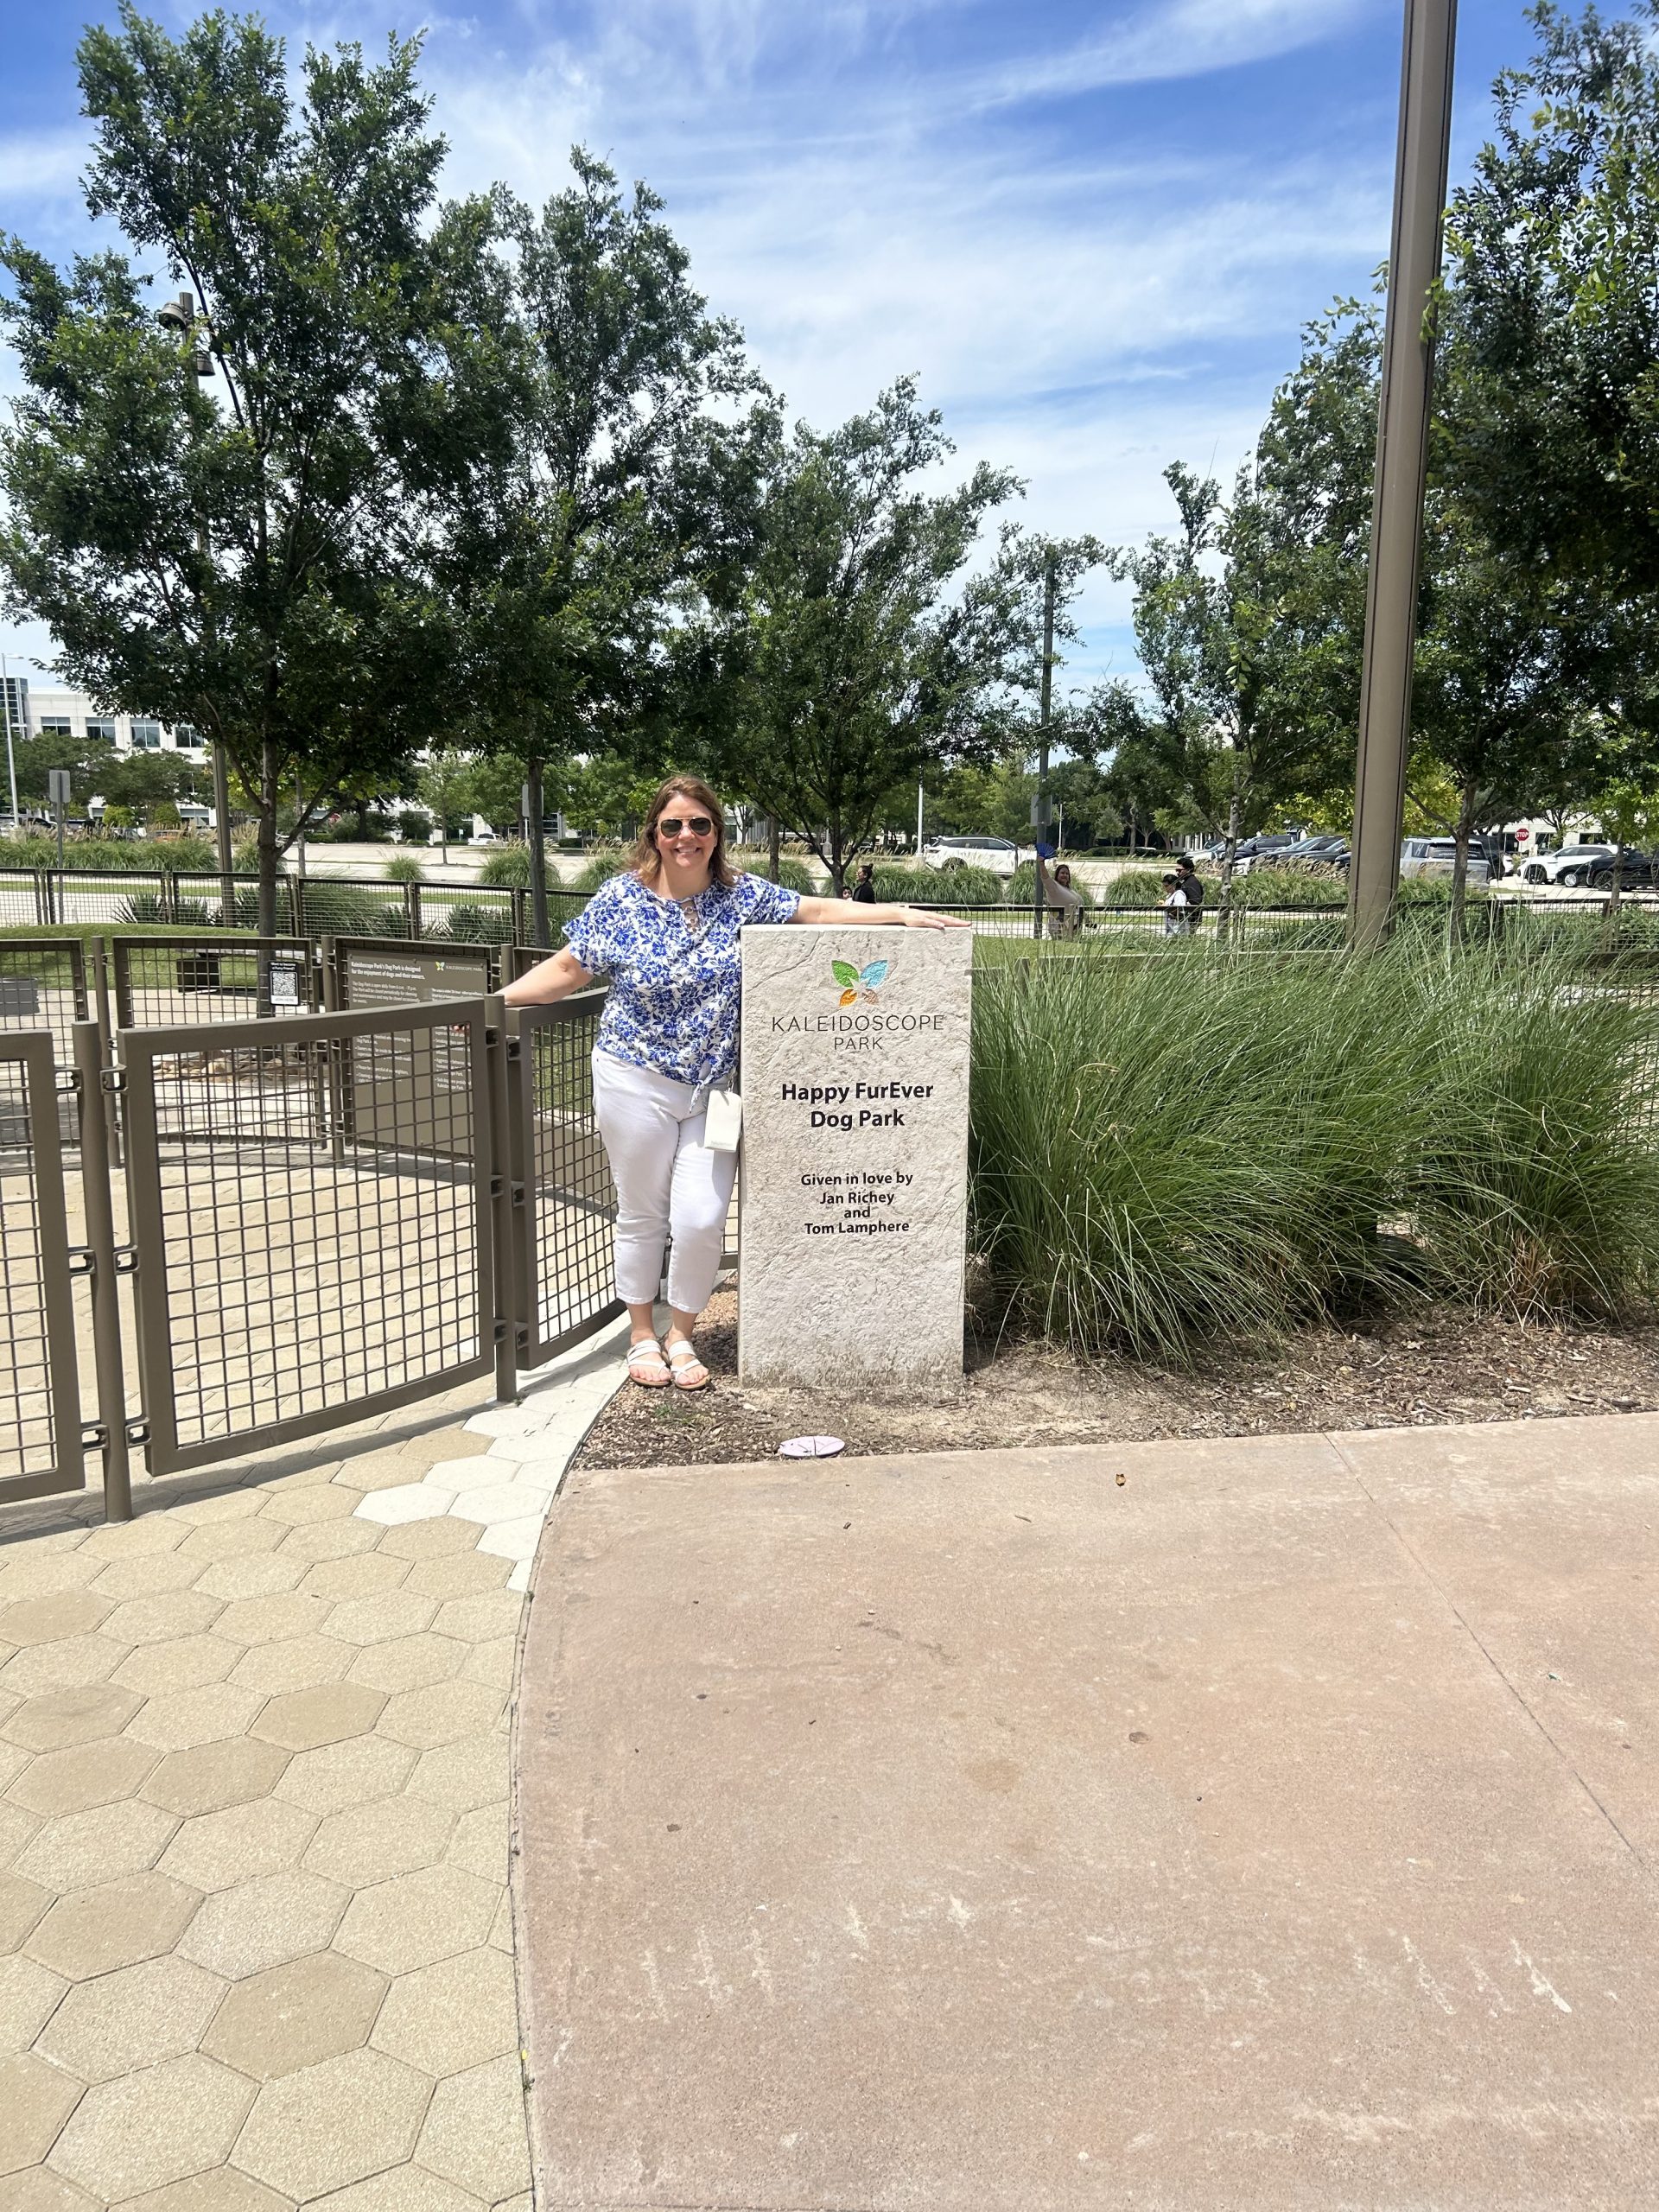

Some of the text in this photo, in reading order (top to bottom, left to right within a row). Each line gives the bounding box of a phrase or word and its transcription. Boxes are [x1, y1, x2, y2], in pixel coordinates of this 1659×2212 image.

[772, 1014, 944, 1033] KALEIDOSCOPE
[834, 1036, 883, 1051] PARK
[782, 1082, 934, 1104] Happy FurEver
[810, 1109, 906, 1132] Dog Park
[801, 1173, 913, 1188] Given in love by
[819, 1192, 895, 1206] Jan Richey
[844, 1206, 871, 1218] and
[804, 1221, 910, 1236] Tom Lamphere
